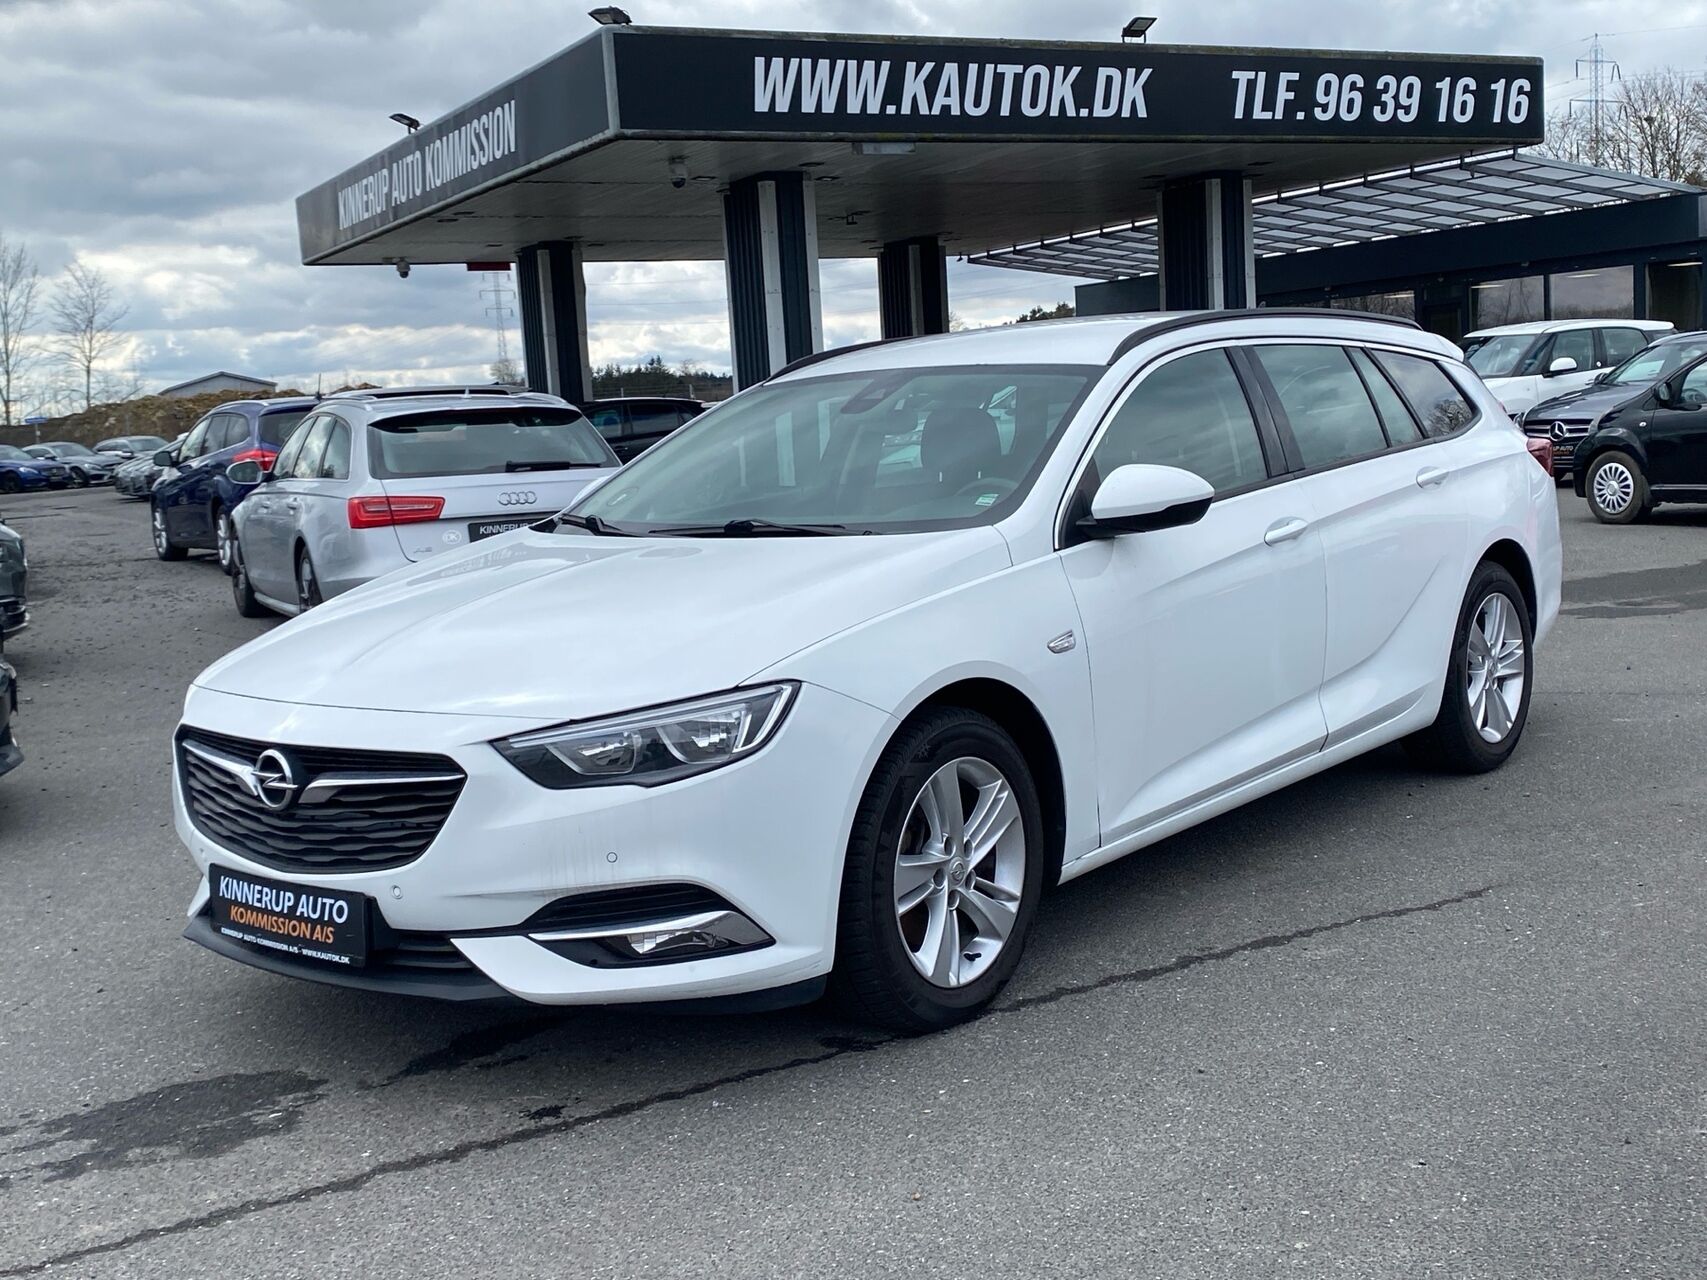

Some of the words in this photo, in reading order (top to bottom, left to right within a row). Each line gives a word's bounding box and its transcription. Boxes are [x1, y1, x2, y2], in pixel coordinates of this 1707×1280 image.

[753, 56, 1153, 118] WWW.KAUTOK.DK
[1231, 70, 1305, 120] TLF.
[1314, 72, 1364, 122] 96
[1373, 74, 1422, 123] 39
[1435, 76, 1477, 123] 16
[1490, 78, 1531, 124] 16
[338, 168, 389, 231] KINNERUP
[391, 150, 422, 206] AUTO
[425, 100, 516, 191] KOMMISSION
[219, 875, 294, 914] KINNERUP
[296, 894, 348, 924] AUTO
[230, 905, 310, 939] KOMMISSION
[313, 924, 335, 944] A/S
